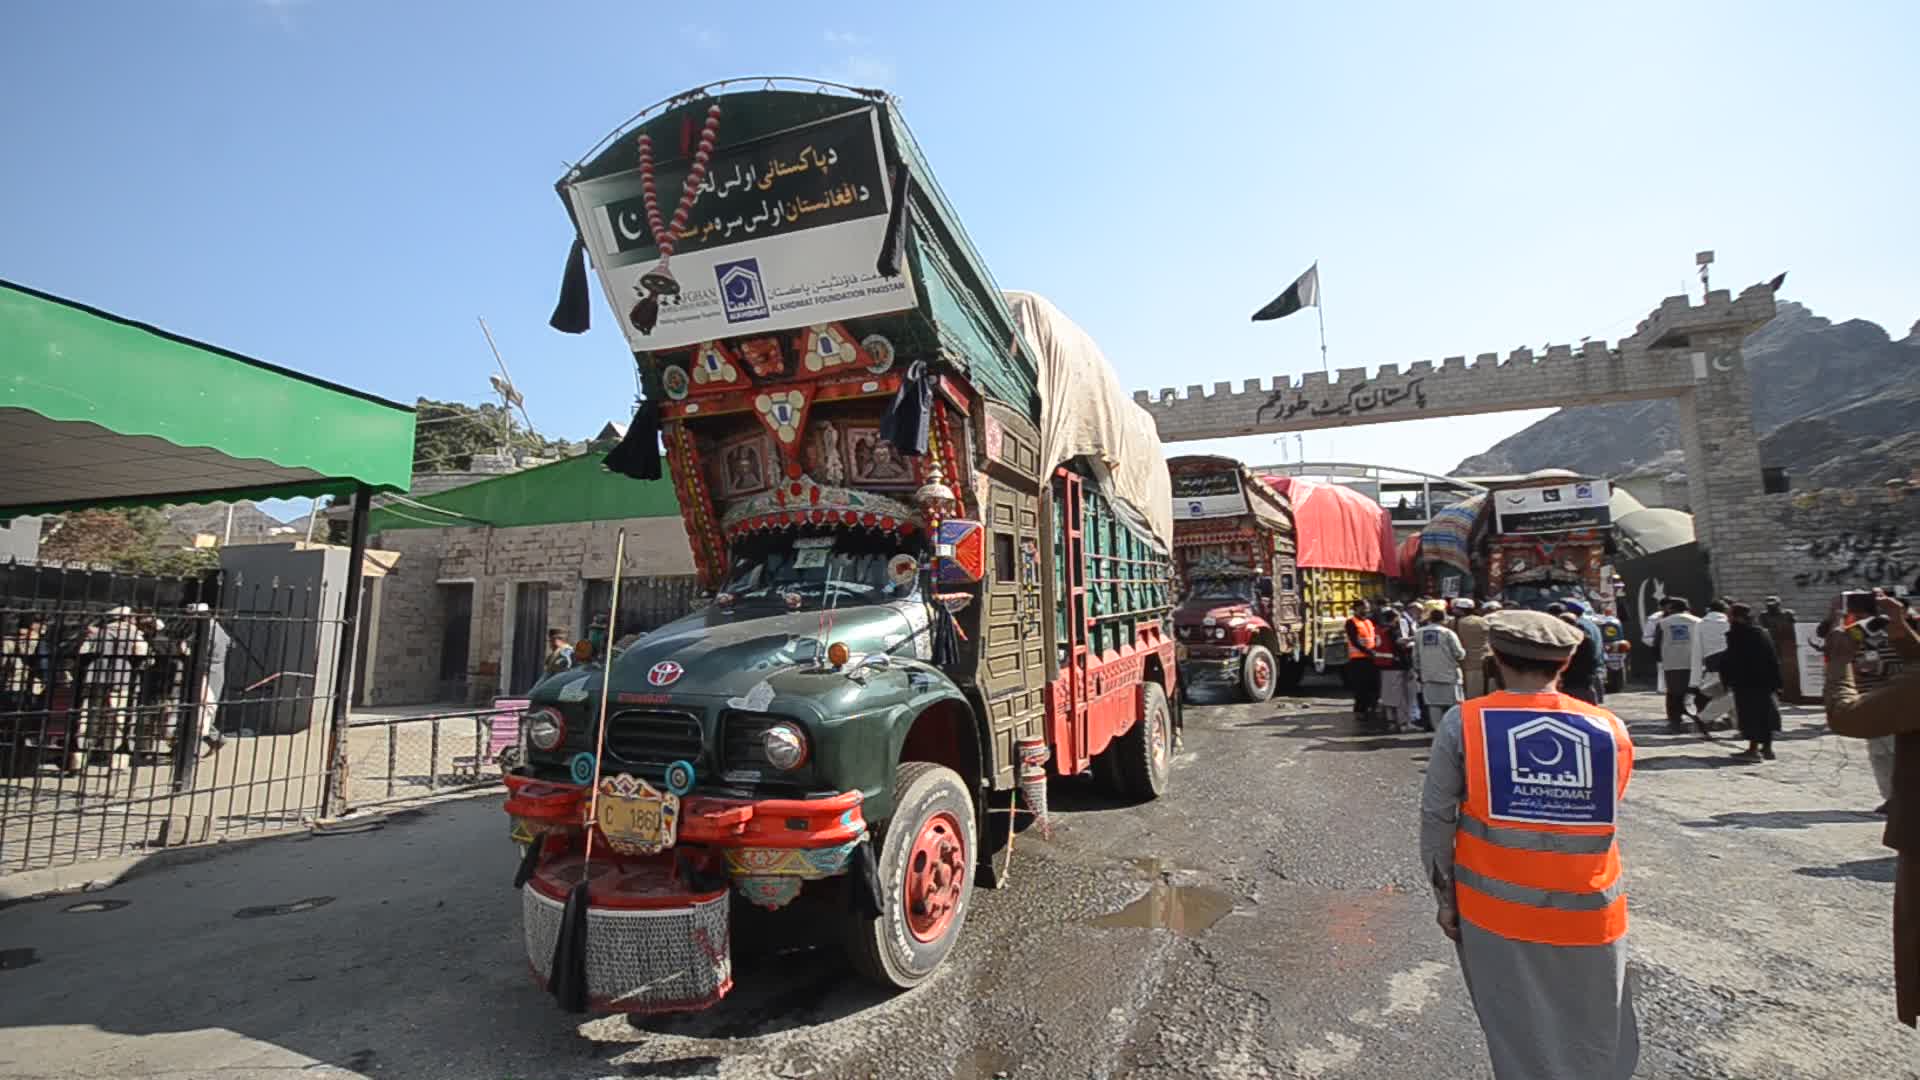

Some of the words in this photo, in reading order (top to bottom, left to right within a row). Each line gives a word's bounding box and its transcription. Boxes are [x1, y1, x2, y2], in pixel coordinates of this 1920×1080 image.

[814, 287, 866, 305] FOUNDATION
[867, 281, 906, 297] PAKISTAN
[1356, 377, 1427, 411] پاکستان
[1513, 785, 1593, 800] ALKHIDMAT
